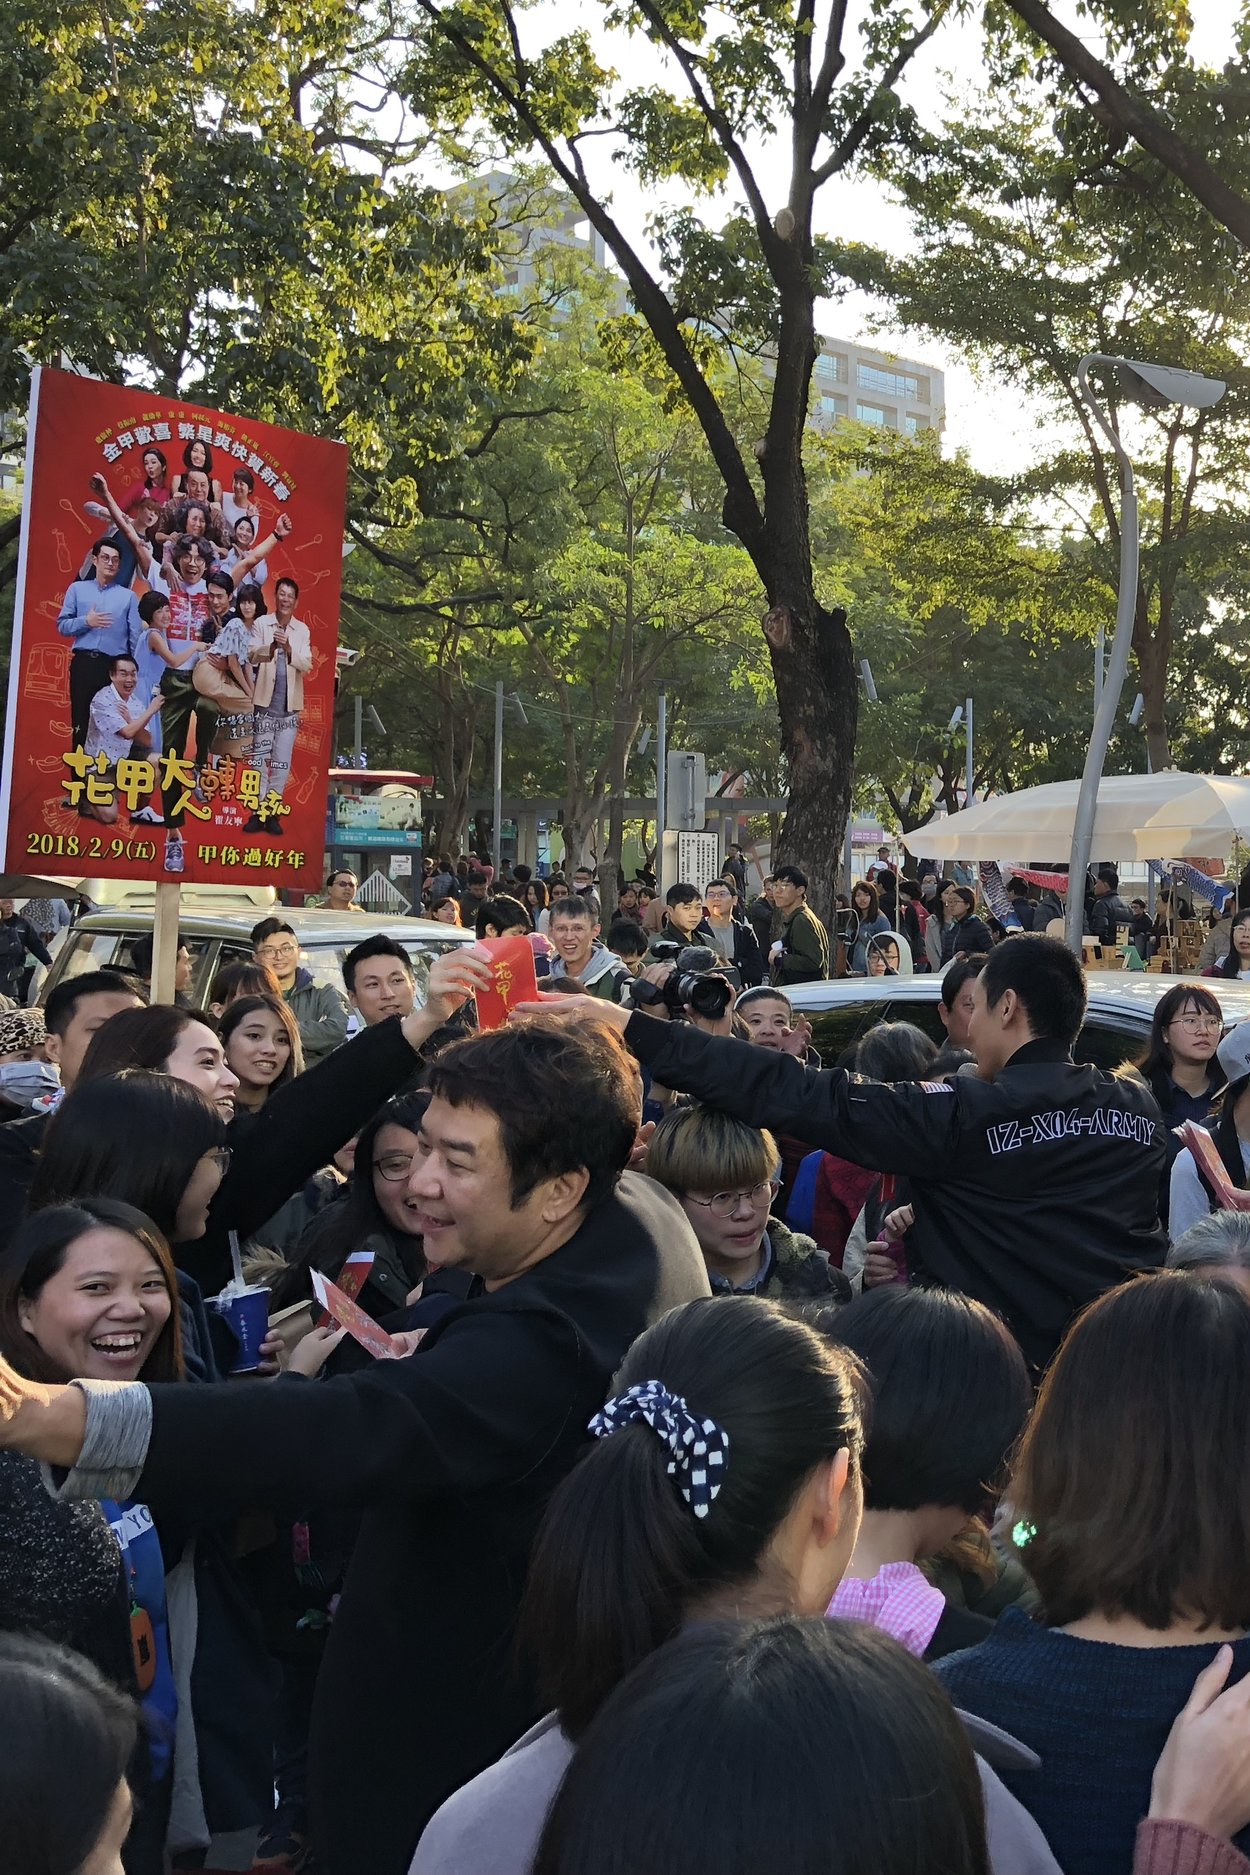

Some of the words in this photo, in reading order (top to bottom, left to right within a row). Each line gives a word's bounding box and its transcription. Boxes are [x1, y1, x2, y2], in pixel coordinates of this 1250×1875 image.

[102, 421, 172, 464] 金甲歡喜
[177, 421, 291, 502] 繁星爽快賀新春
[62, 743, 292, 823] 花甲大人轉男孩
[26, 832, 156, 860] 2018/2/9(五)
[198, 844, 305, 870] 甲你過好年
[494, 961, 516, 1013] 花甲
